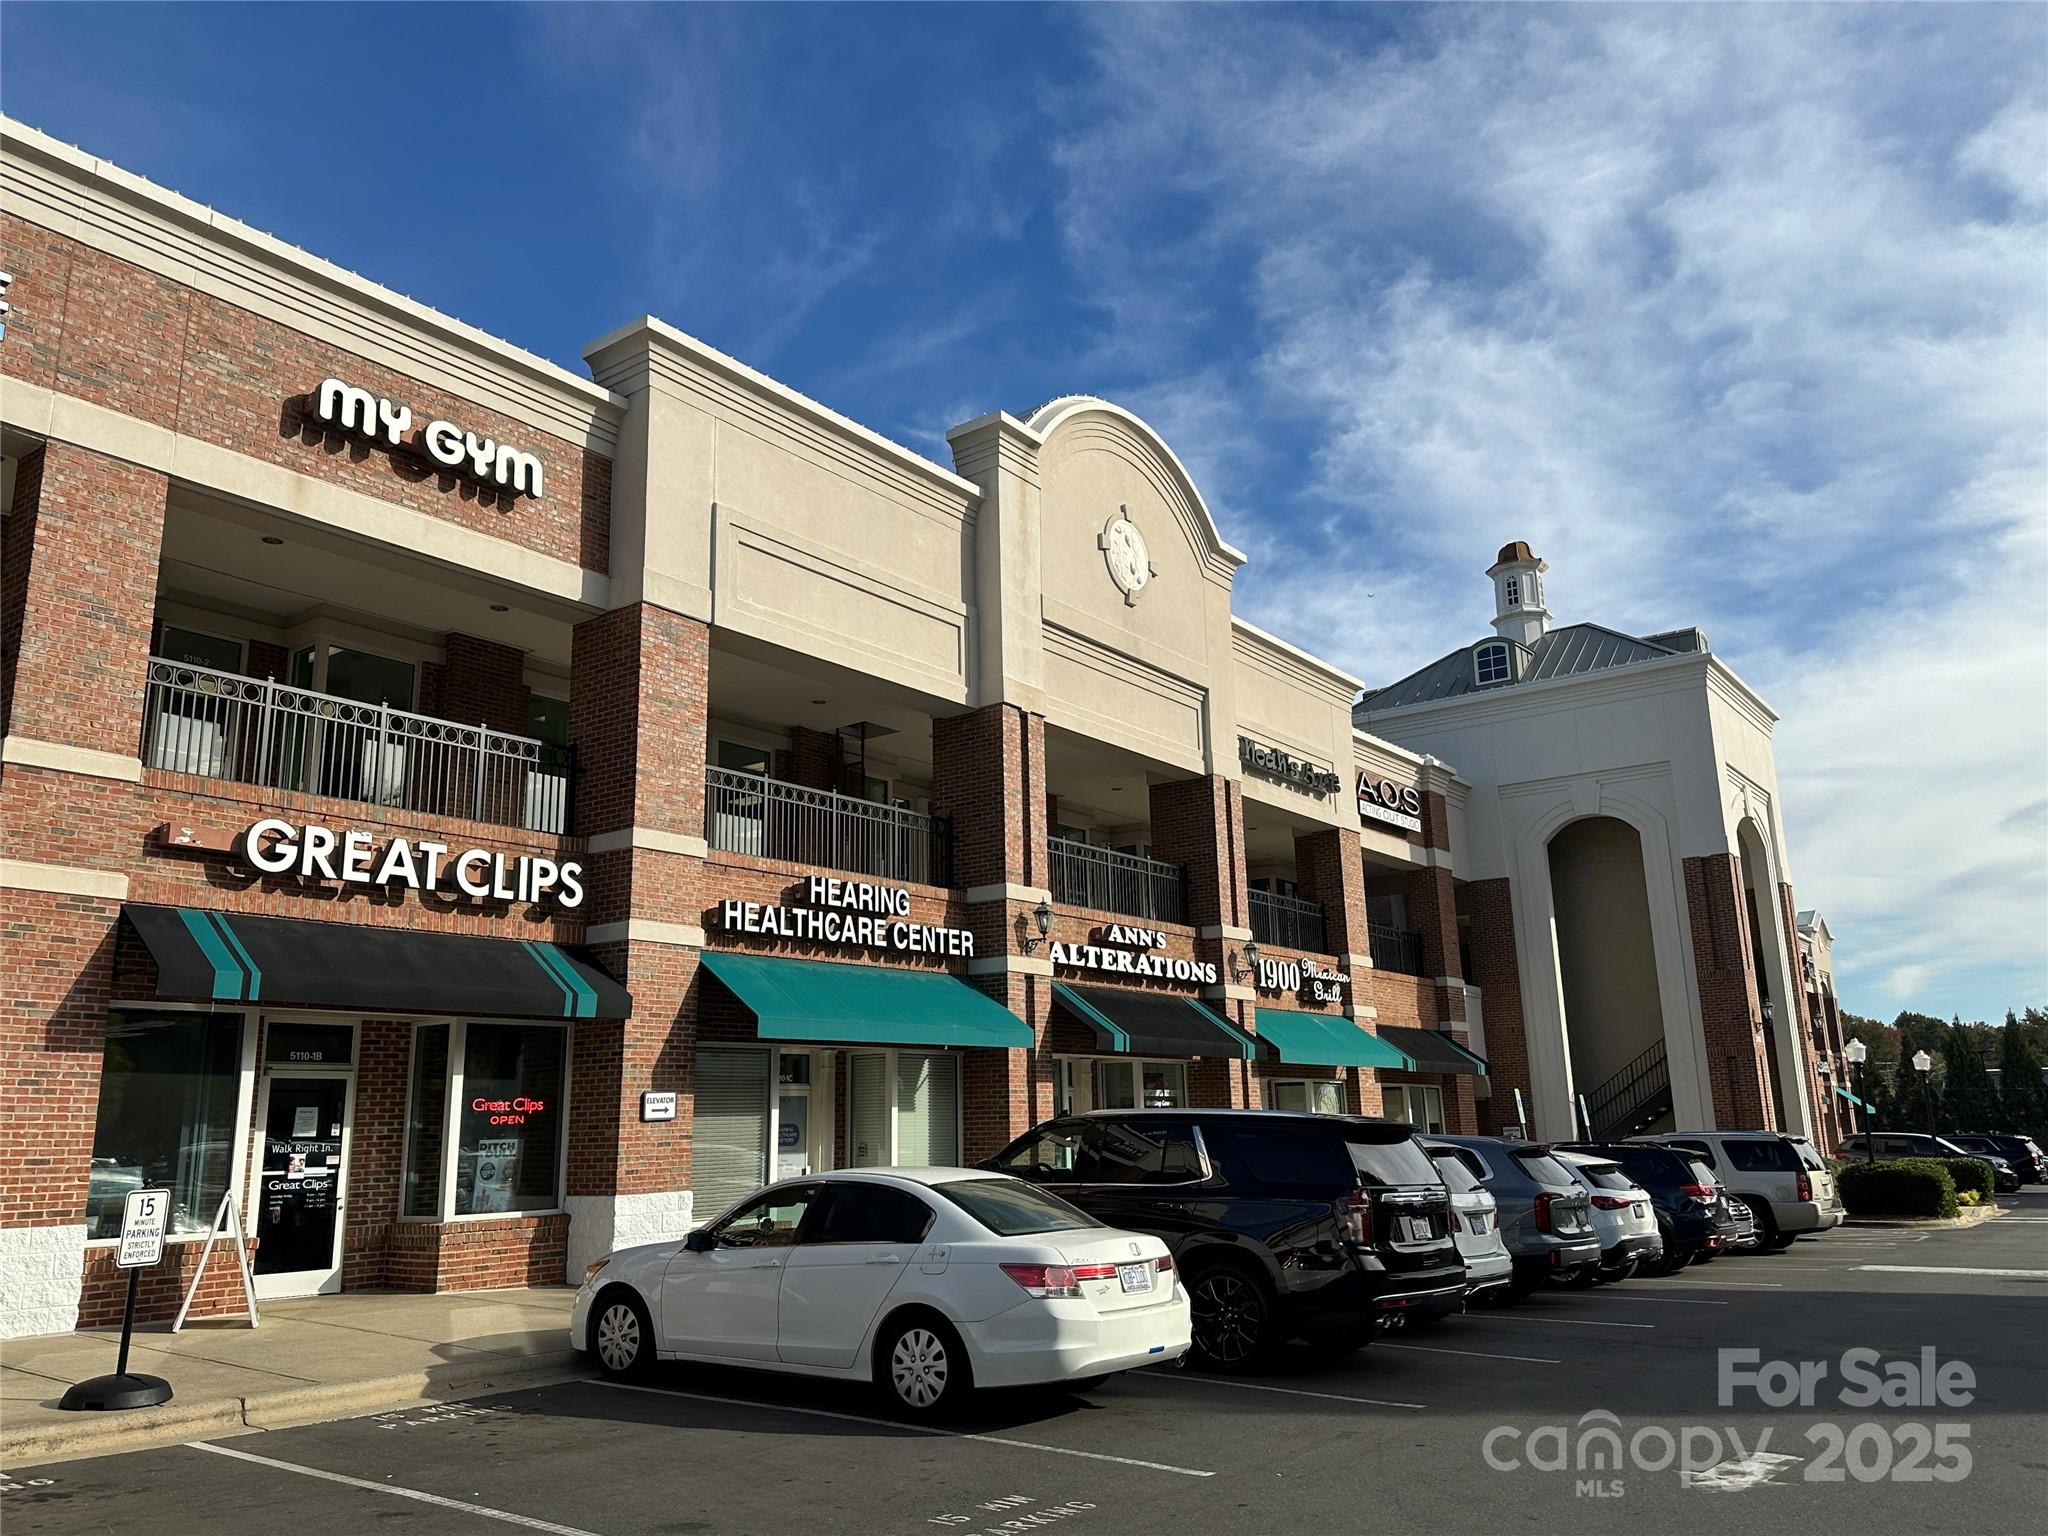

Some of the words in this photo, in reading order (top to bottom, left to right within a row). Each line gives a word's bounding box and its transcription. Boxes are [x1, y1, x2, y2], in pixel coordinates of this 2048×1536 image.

[1361, 802, 1382, 818] ACTING
[1382, 809, 1400, 824] OUT
[1400, 814, 1420, 831] STUDIO
[246, 818, 448, 891] GREAT
[455, 848, 584, 908] CLIPS
[810, 875, 910, 916] HEARING
[725, 899, 888, 947] HEALTHCARE
[893, 921, 974, 957] CENTER
[1108, 923, 1167, 949] ANN'S
[1050, 940, 1218, 984] ALTERATIONS
[1258, 958, 1301, 992] 1900
[1301, 957, 1351, 983] Mexican
[1313, 980, 1343, 1003] Grill
[472, 1098, 511, 1112] Great
[512, 1097, 544, 1114] Clips
[646, 1096, 675, 1105] ELEVATOR
[490, 1115, 525, 1125] OPEN
[271, 1143, 292, 1154] Walk
[295, 1143, 319, 1155] Right
[321, 1143, 334, 1153] In.
[480, 1142, 516, 1151] DITCH
[268, 1180, 301, 1191] Great
[302, 1178, 328, 1191] Clips
[139, 1197, 156, 1217] 15
[134, 1217, 156, 1226] MINUTE
[125, 1227, 160, 1240] PARKING
[127, 1240, 156, 1250] STRICTLY
[123, 1249, 156, 1260] ENFORCED
[927, 1513, 971, 1527] 15
[965, 1501, 1097, 1536] ARKING
